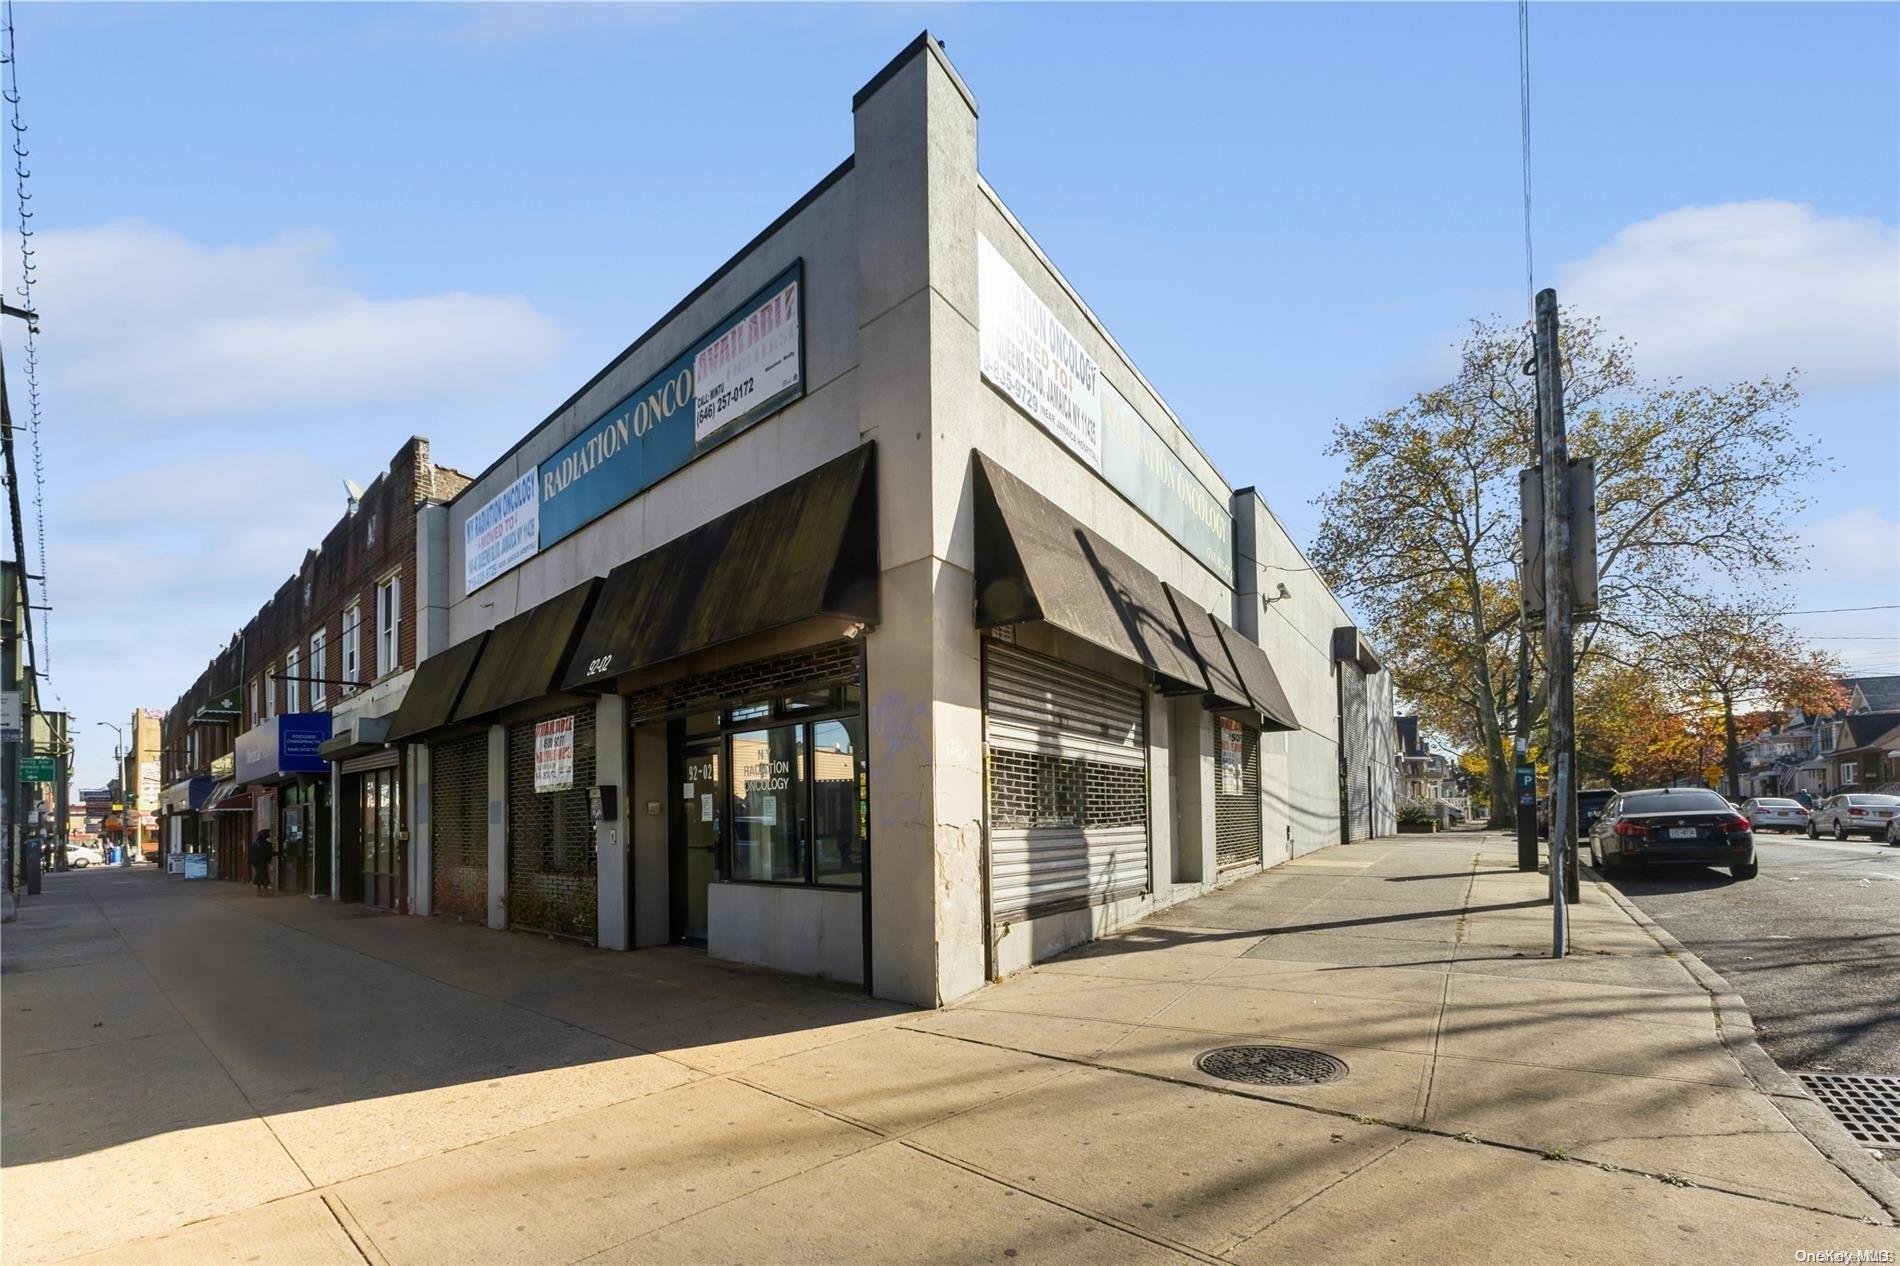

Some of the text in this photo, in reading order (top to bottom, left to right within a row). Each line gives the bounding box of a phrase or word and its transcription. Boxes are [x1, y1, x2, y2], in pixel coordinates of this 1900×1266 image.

[1049, 318, 1097, 396] ONCOLOGY
[696, 377, 754, 429] (646) 257-0172
[982, 351, 1038, 413] 8-835-9729
[996, 334, 1026, 380] QUEENS
[1046, 376, 1073, 422] JAMAICA
[1072, 400, 1080, 431] NY
[542, 368, 694, 501] RADIATION ONCO
[502, 471, 535, 518] ONCOLOGY
[1178, 472, 1227, 543] ONCOLOGY
[480, 515, 515, 549] MOVED TO
[587, 654, 612, 677] 92-02
[688, 763, 712, 781] 92-02
[745, 777, 789, 792] ONCOLOGY
[1524, 776, 1532, 786] P
